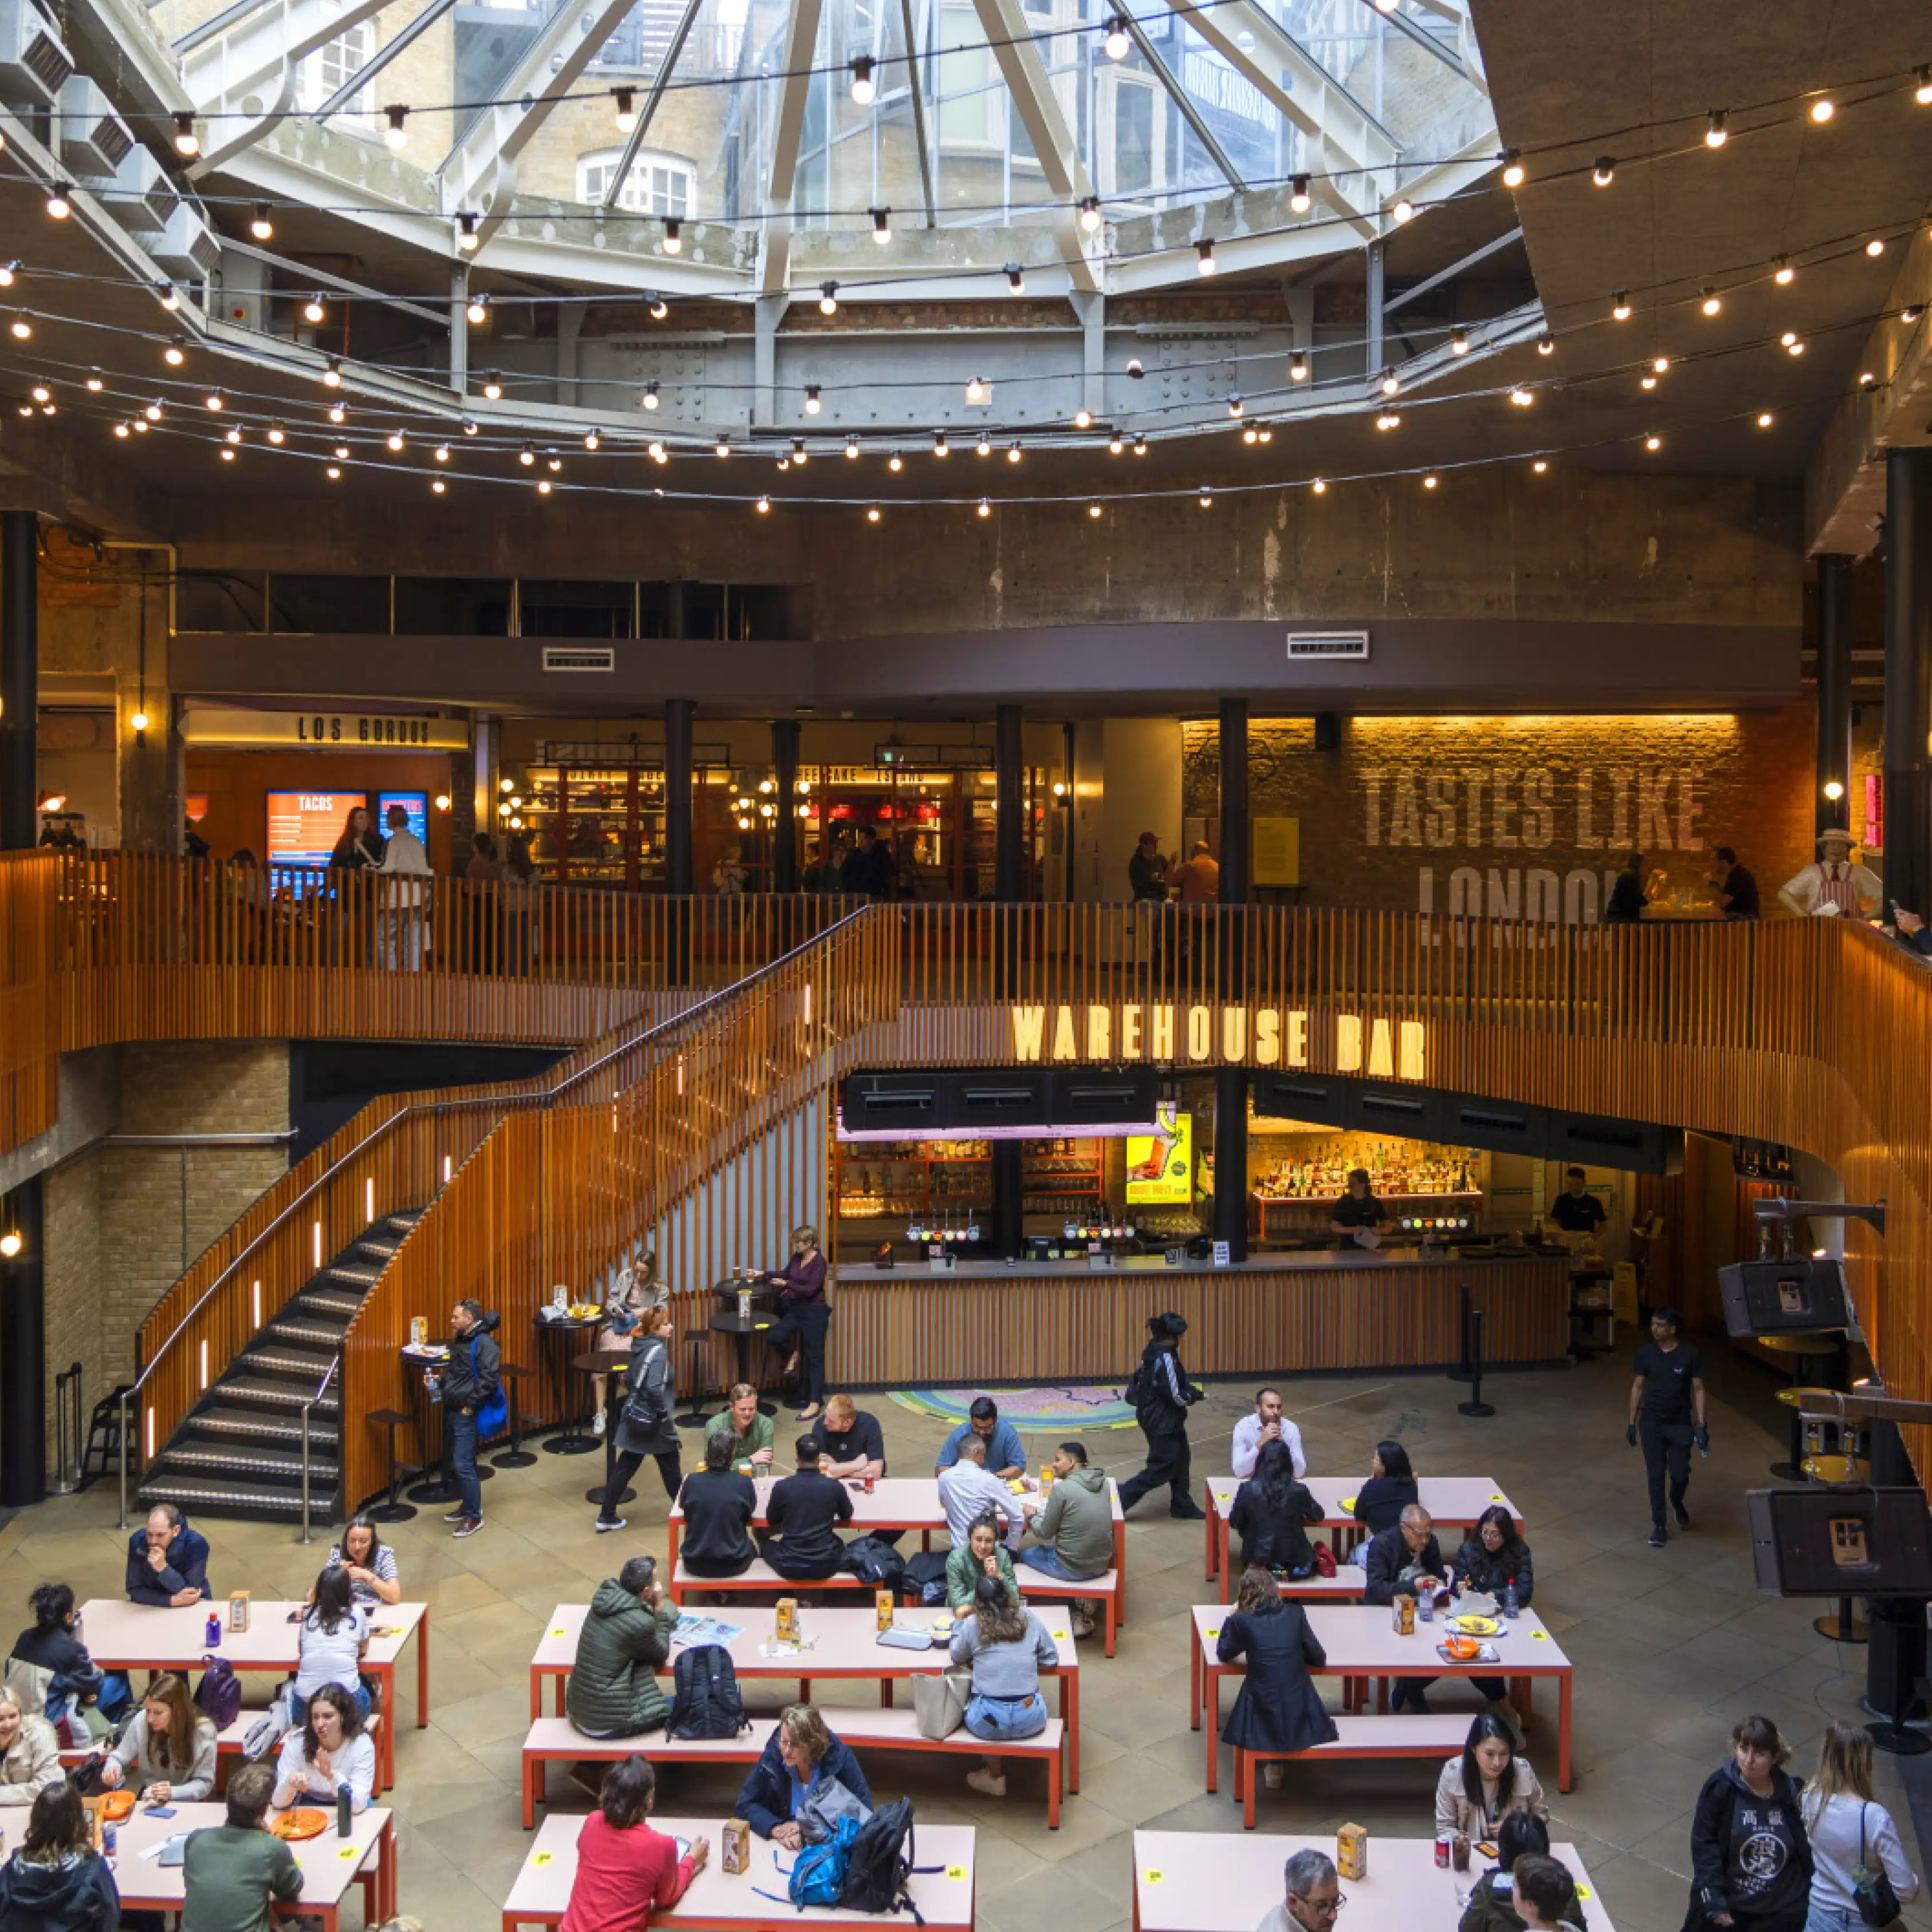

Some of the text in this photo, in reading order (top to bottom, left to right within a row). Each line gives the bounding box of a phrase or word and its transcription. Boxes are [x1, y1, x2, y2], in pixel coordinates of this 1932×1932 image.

[299, 717, 429, 743] LOS GORDOS
[299, 795, 333, 811] TACOS
[1359, 768, 1554, 848] TASTES
[1577, 768, 1705, 851] LIKE
[1012, 1004, 1424, 1080] WAREHOUSE BAR
